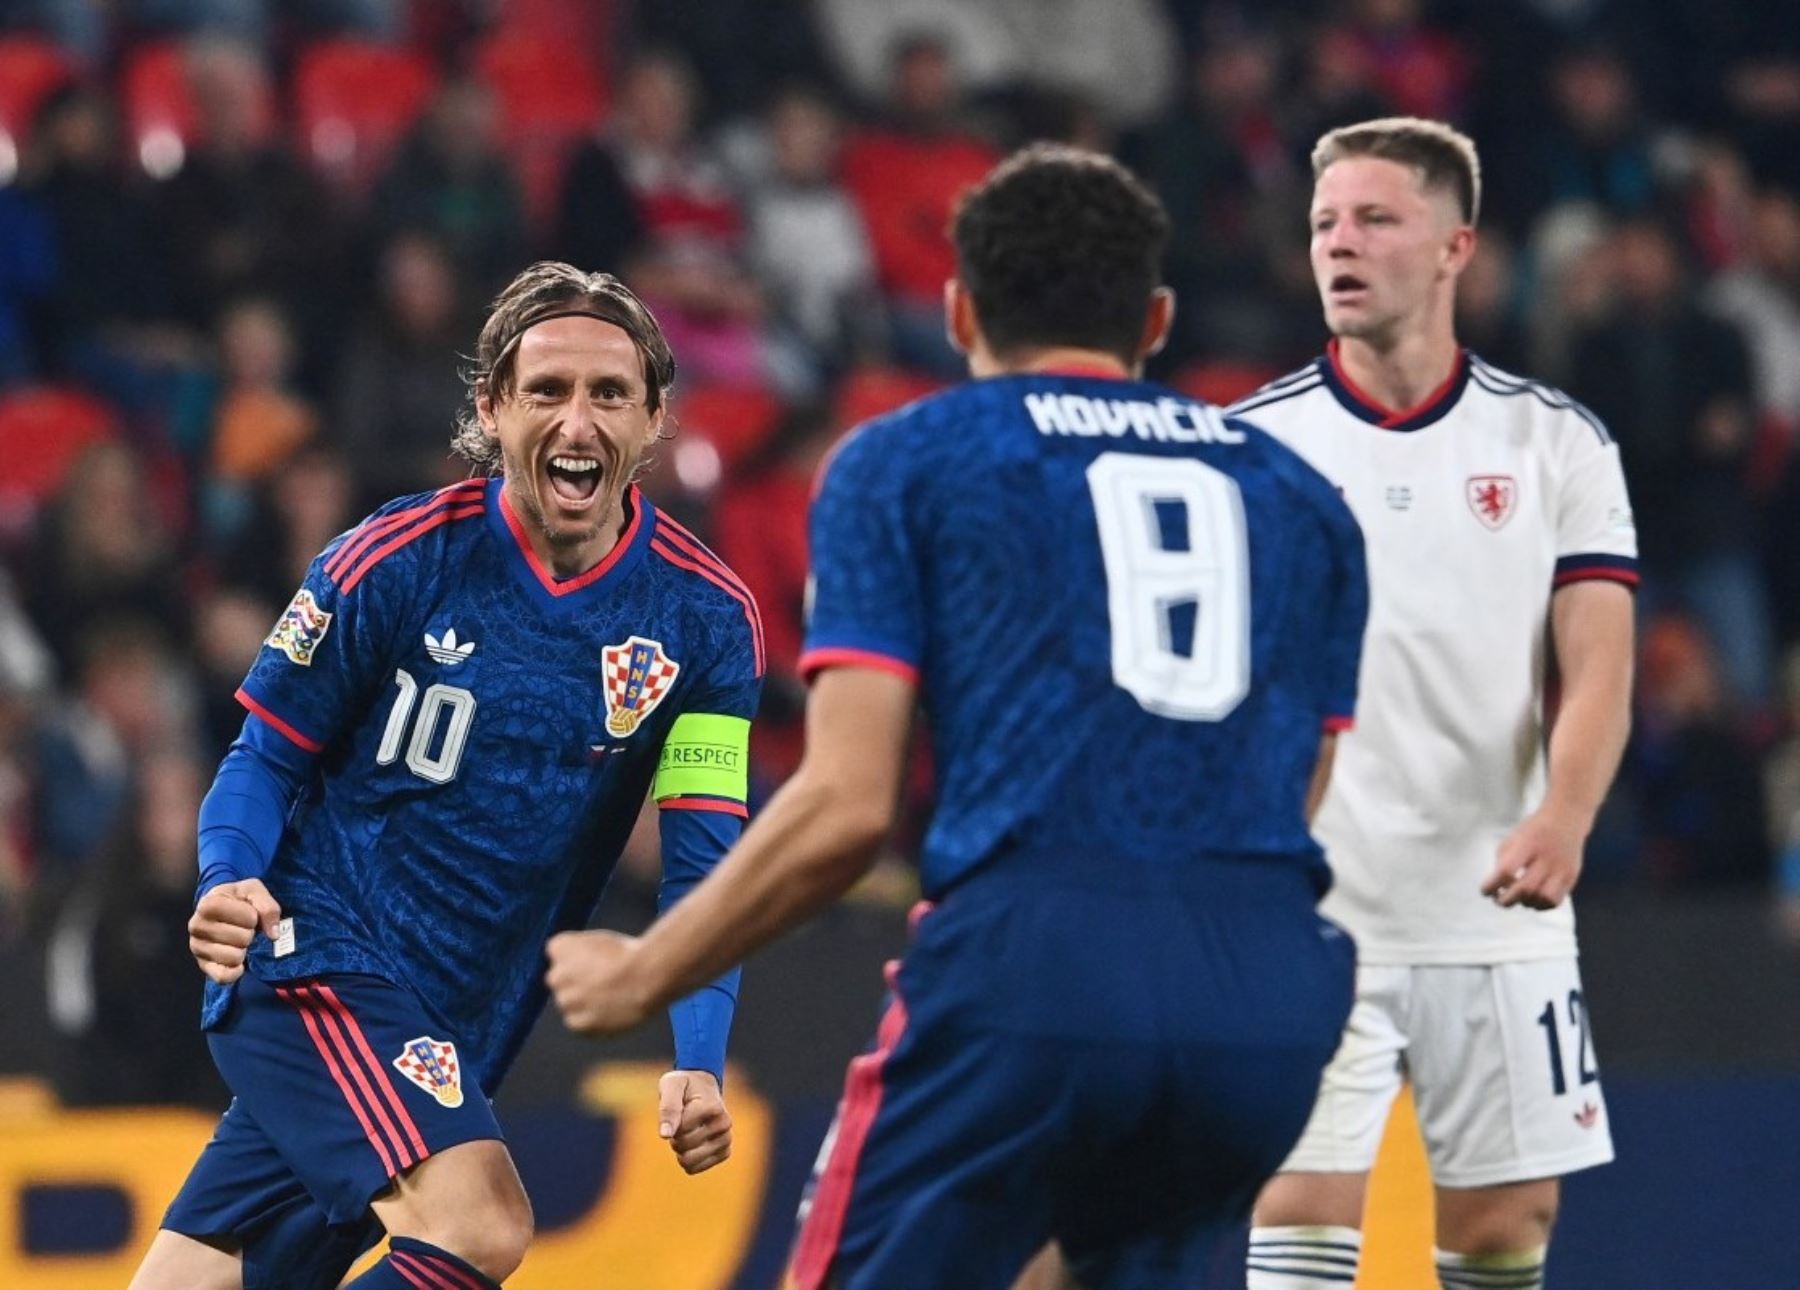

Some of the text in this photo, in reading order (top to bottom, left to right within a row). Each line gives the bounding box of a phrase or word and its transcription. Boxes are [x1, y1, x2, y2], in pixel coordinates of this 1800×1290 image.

[1086, 452, 1252, 723] 8
[376, 667, 477, 784] 10
[627, 649, 648, 699] HNS
[673, 747, 738, 768] RESPECT
[1537, 989, 1598, 1096] 12
